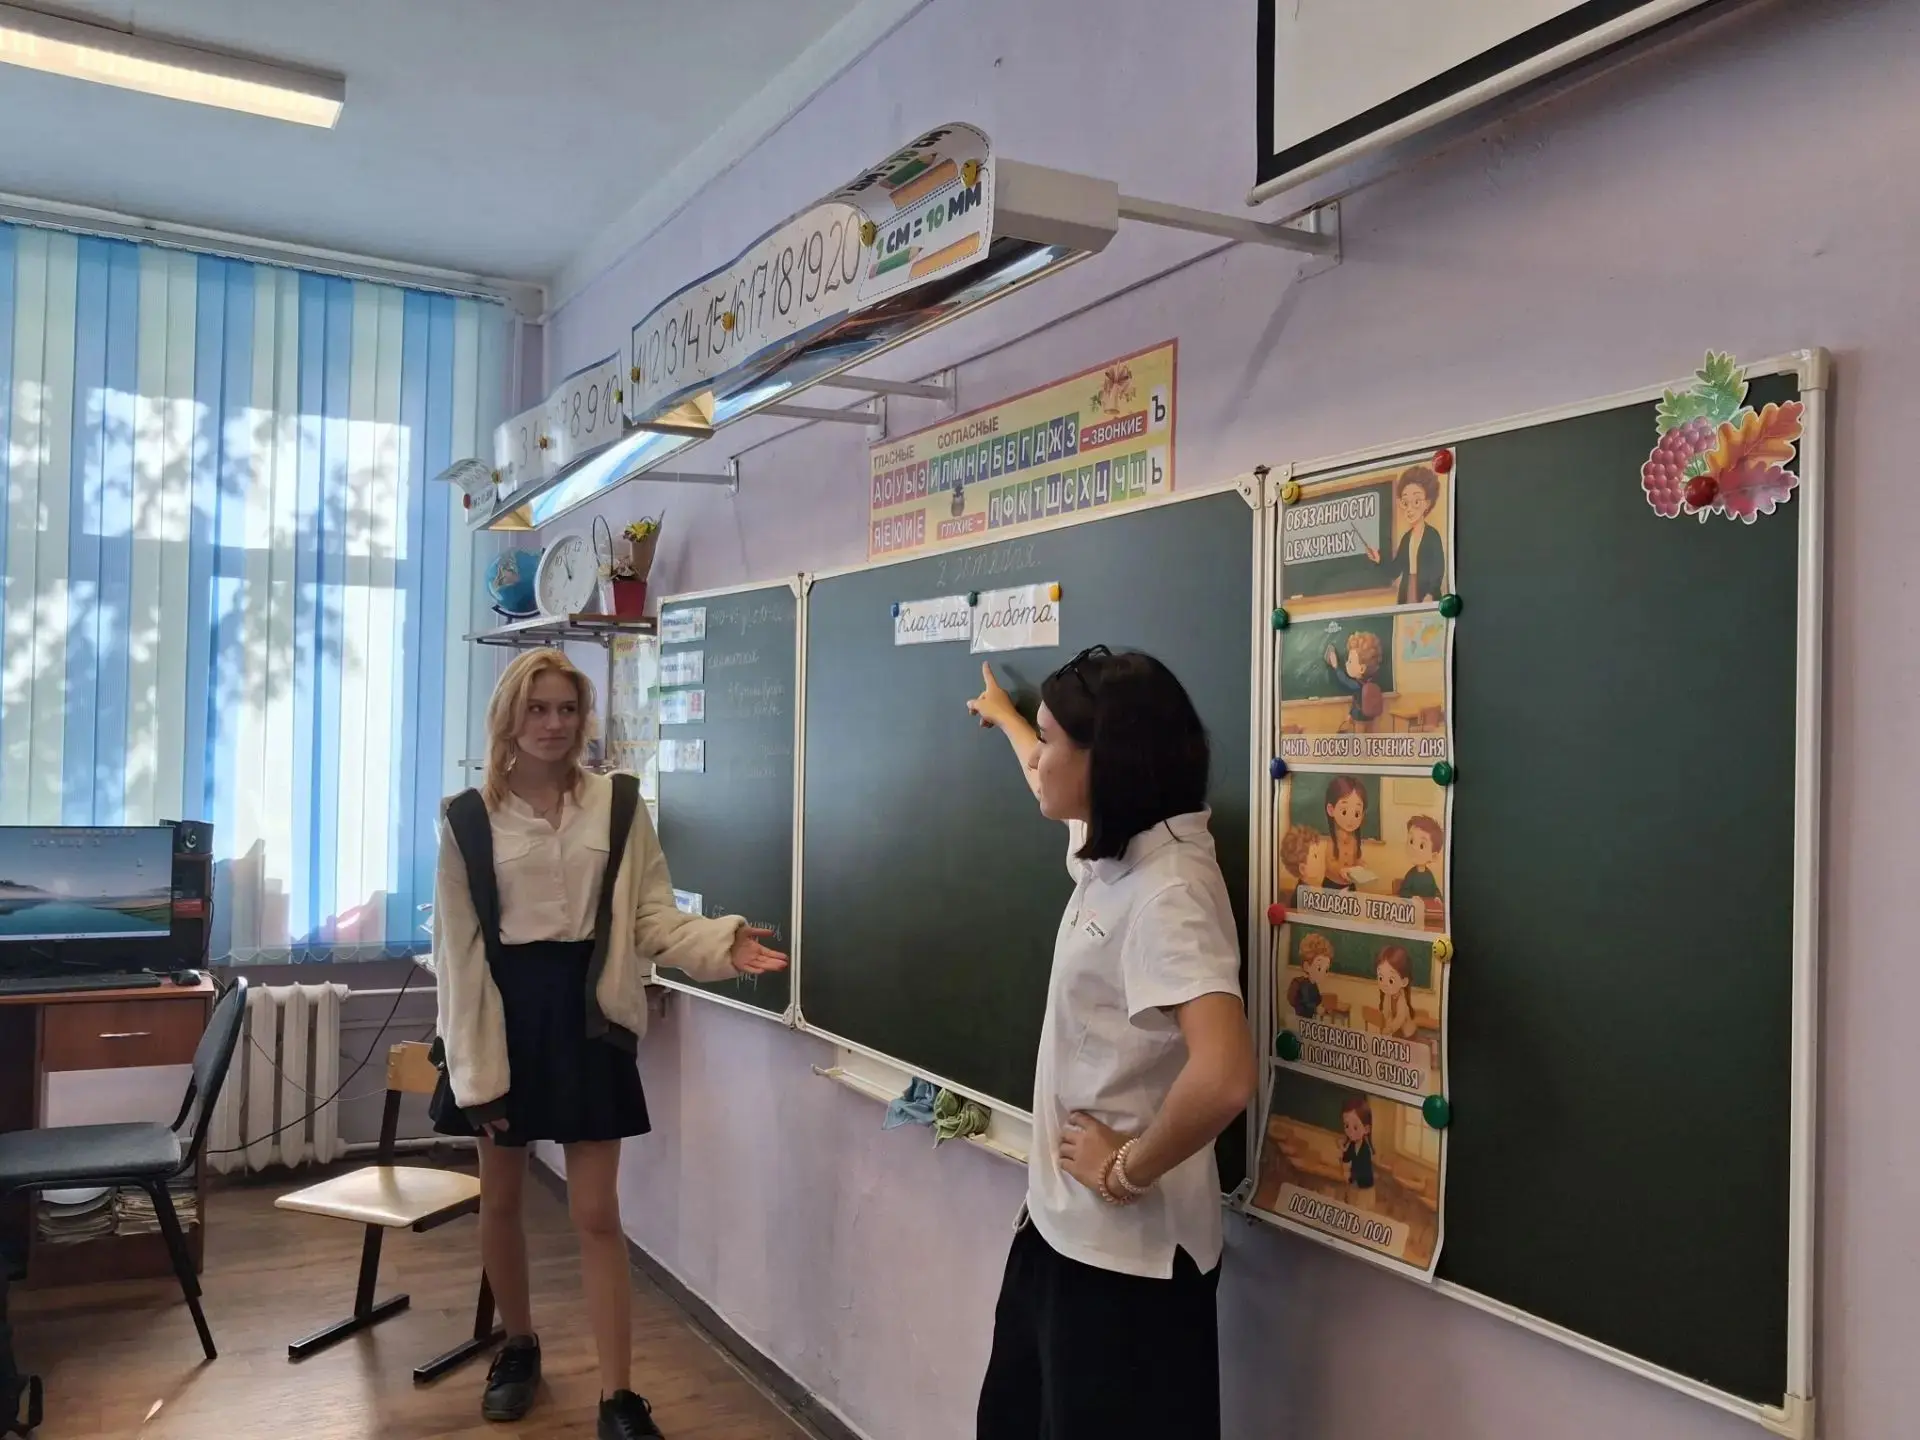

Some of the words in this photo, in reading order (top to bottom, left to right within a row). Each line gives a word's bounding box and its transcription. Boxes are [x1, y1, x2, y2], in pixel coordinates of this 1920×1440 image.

[875, 237, 884, 260] 1
[886, 222, 911, 254] СМ
[926, 203, 945, 233] 10
[664, 318, 678, 380] 13
[681, 308, 701, 368] 14
[705, 291, 728, 358] 15
[731, 278, 746, 347] 16
[748, 260, 769, 334] 17
[771, 246, 795, 321] 18
[797, 230, 824, 307] 19
[823, 213, 862, 295] 20
[570, 391, 582, 439] 8
[585, 384, 599, 433] 9
[602, 374, 620, 428] 10
[1151, 395, 1166, 423] Ъ
[937, 416, 1000, 449] СОГЛАСНЫЕ
[1091, 416, 1143, 445] ЗВОНКИЕ
[873, 444, 915, 470] ГЛАСНЫЕ
[1151, 457, 1163, 486] Ь
[940, 518, 973, 538] ГЛУХИЕ
[1285, 494, 1376, 532] ОБЯЗАННОСТИ
[1284, 531, 1357, 561] ДЕЖУРНЫХ
[1281, 737, 1309, 757] МЫТЬ
[1312, 738, 1350, 759] ДОСКУ
[1353, 737, 1362, 757] В
[1365, 737, 1415, 759] ТЕЧЕНИЕ
[1418, 737, 1446, 760] ДНЯ
[1302, 889, 1361, 917] РАЗДАВАТЬ
[1365, 898, 1416, 925] ТЕТРАДИ
[1299, 1019, 1368, 1053] РАССТАВЛЯТЬ
[1371, 1037, 1411, 1064] ПАРТЫ
[1307, 1044, 1373, 1078] ПОДНИМАТЬ
[1375, 1061, 1420, 1090] СТУЛЬЯ
[1288, 1191, 1361, 1236] ПОДМЕТАТЬ
[1363, 1219, 1393, 1247] ПОЛ
